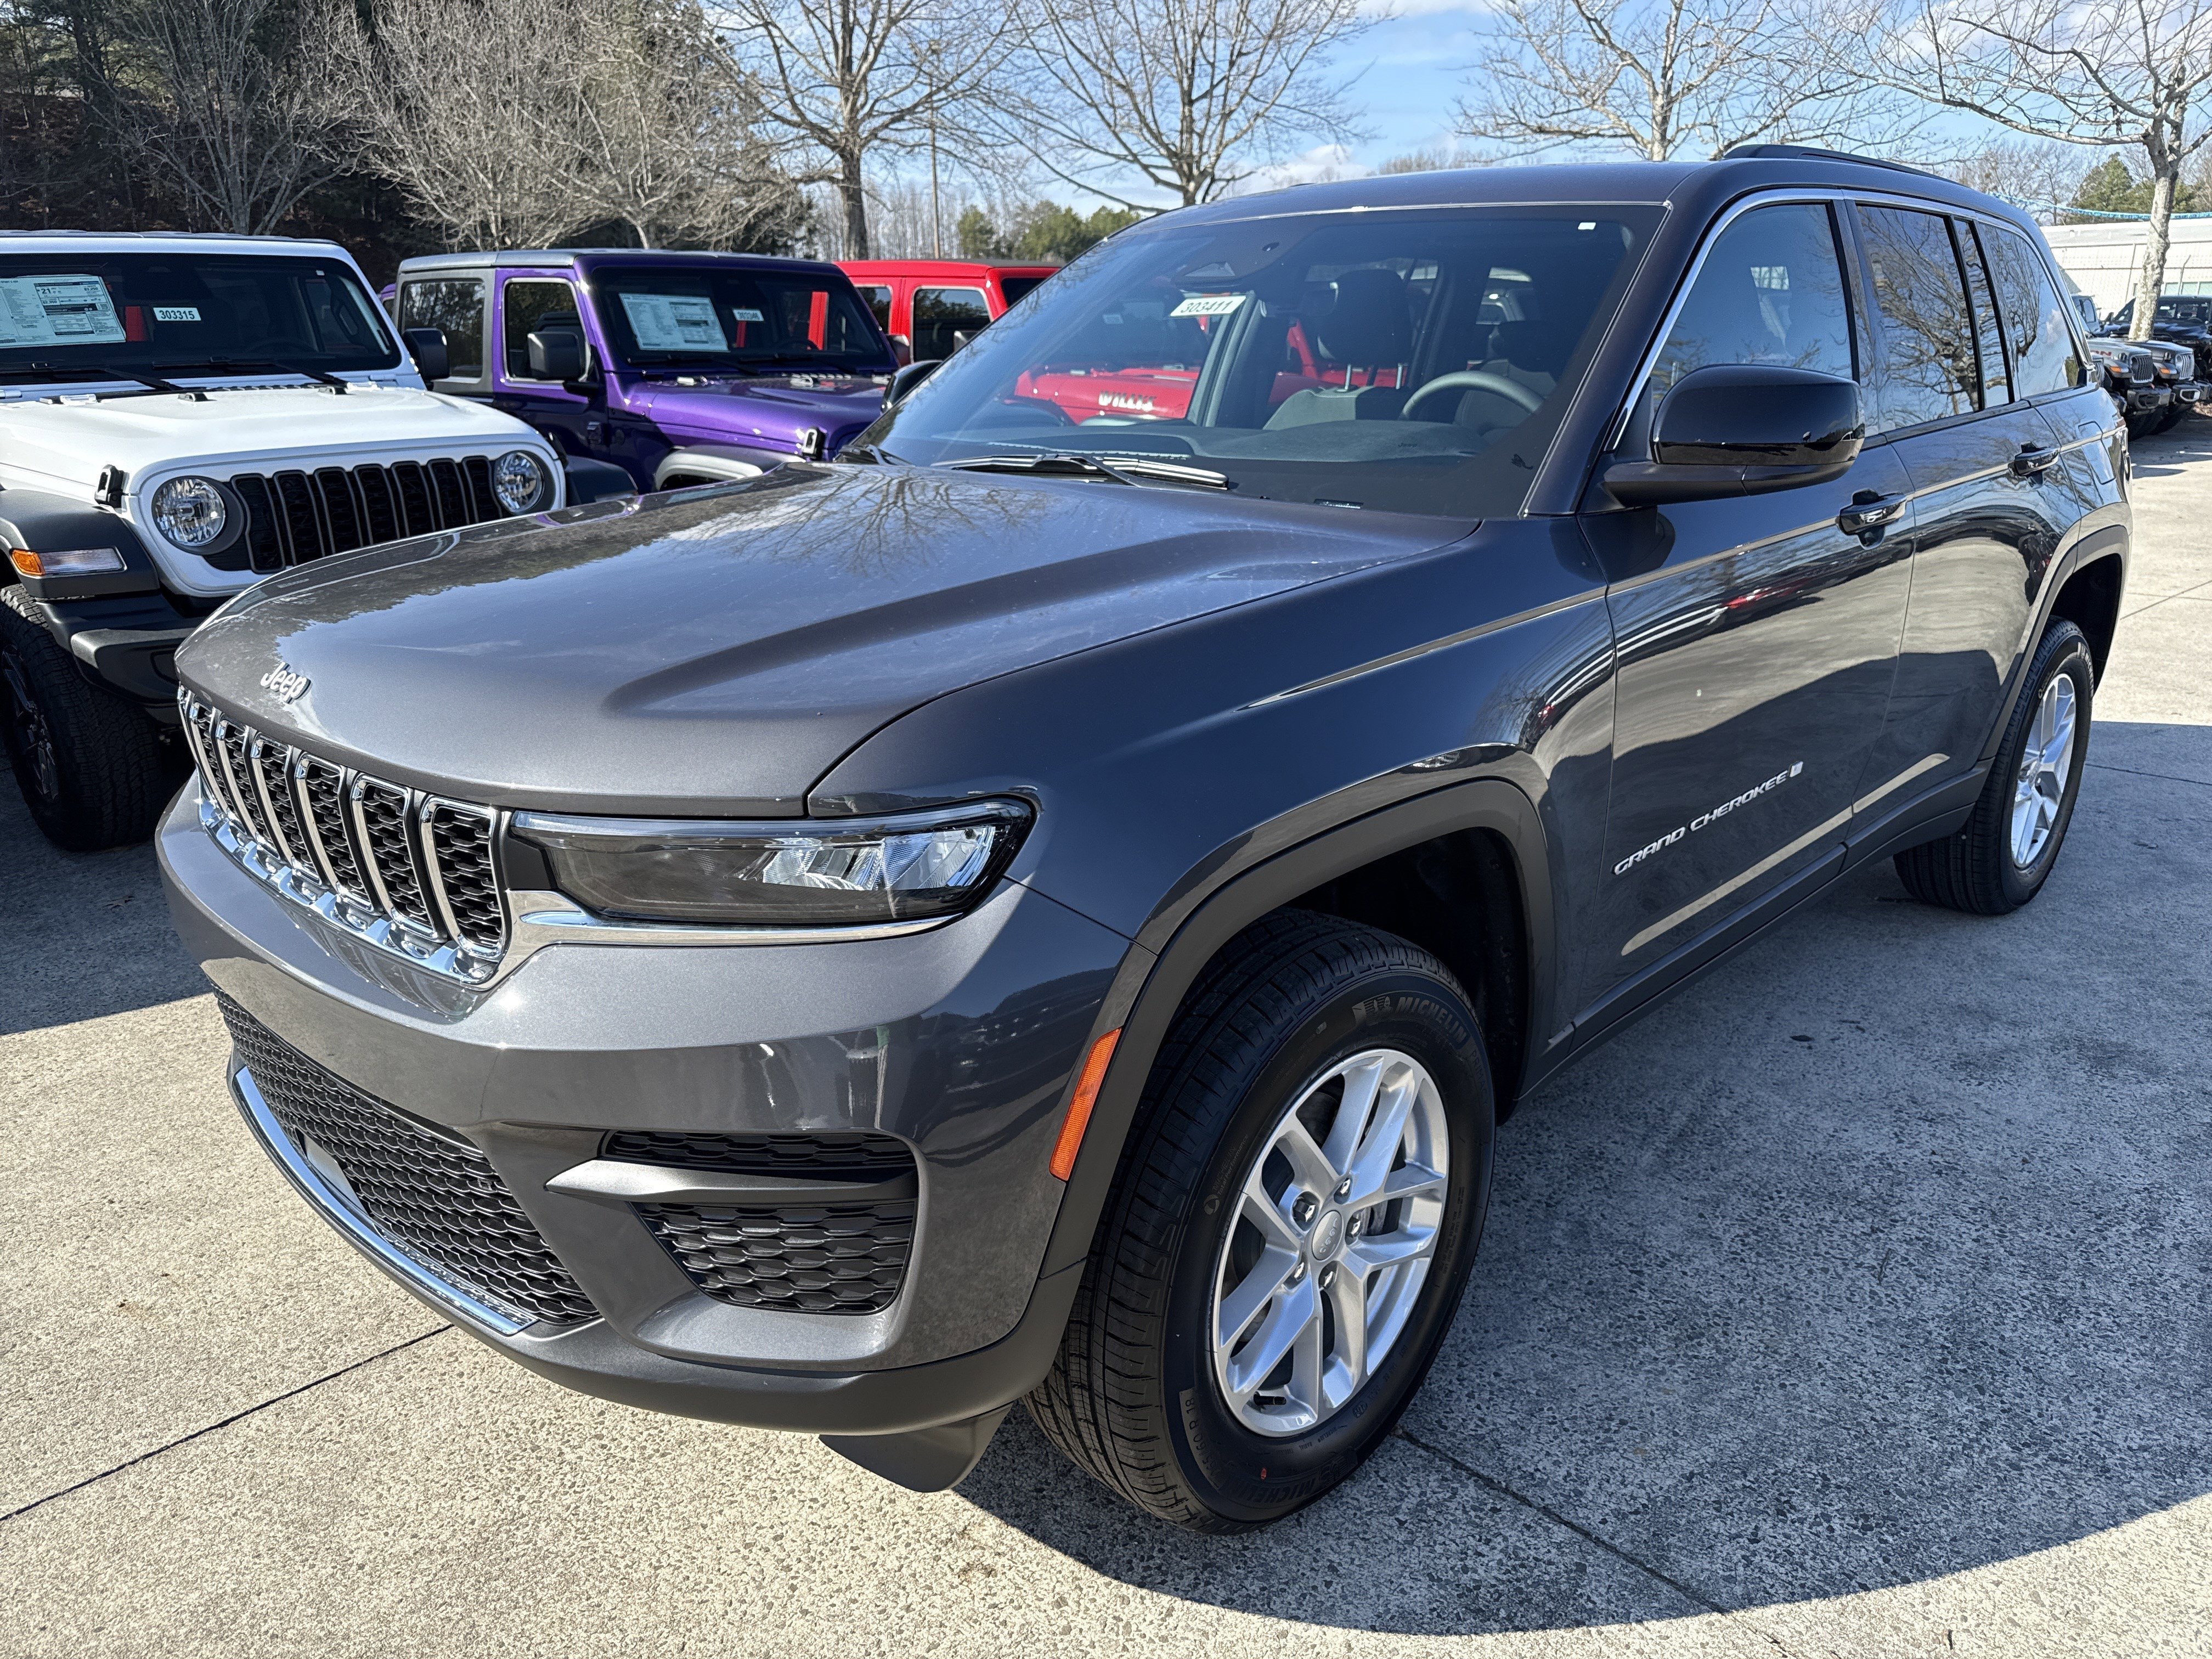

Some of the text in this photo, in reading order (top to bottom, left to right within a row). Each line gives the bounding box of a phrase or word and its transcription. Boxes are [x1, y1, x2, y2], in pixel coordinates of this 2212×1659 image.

[159, 310, 195, 319] 303315
[1181, 301, 1233, 313] 303411
[260, 661, 311, 704] Jeep
[1613, 770, 1788, 876] GRAND CHEROKEE
[1395, 996, 1469, 1043] MICHELIN
[1319, 1217, 1337, 1253] Jeep
